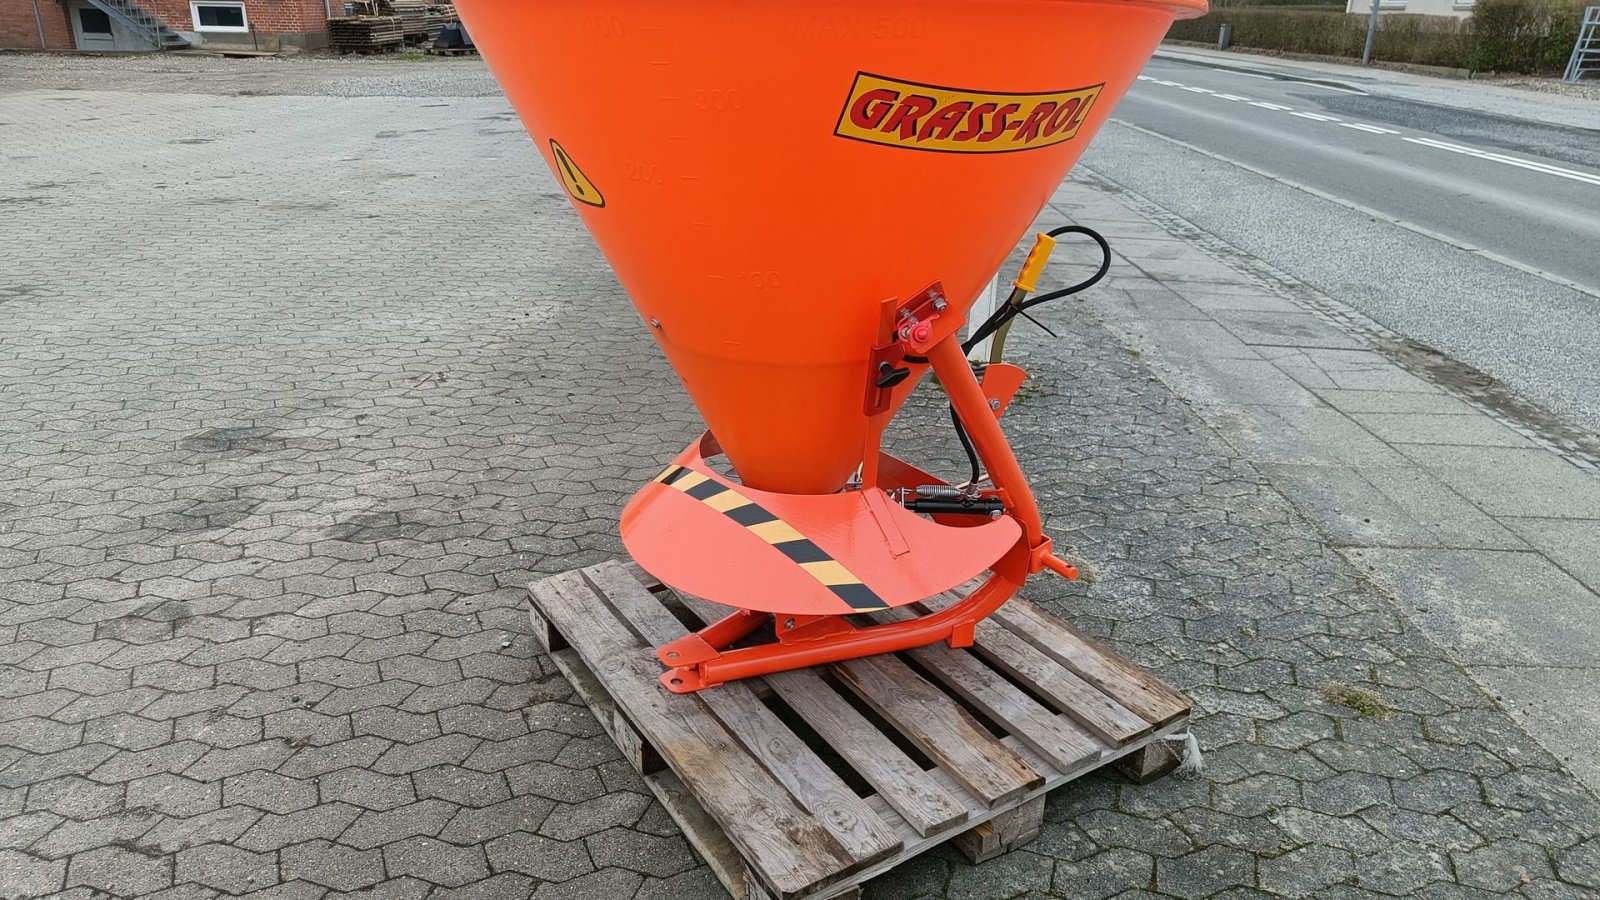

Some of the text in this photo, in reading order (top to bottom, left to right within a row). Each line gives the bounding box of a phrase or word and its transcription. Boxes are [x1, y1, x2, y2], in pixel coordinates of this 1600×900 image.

[791, 12, 926, 40] MAX 500
[849, 88, 1094, 144] GRASS-ROL
